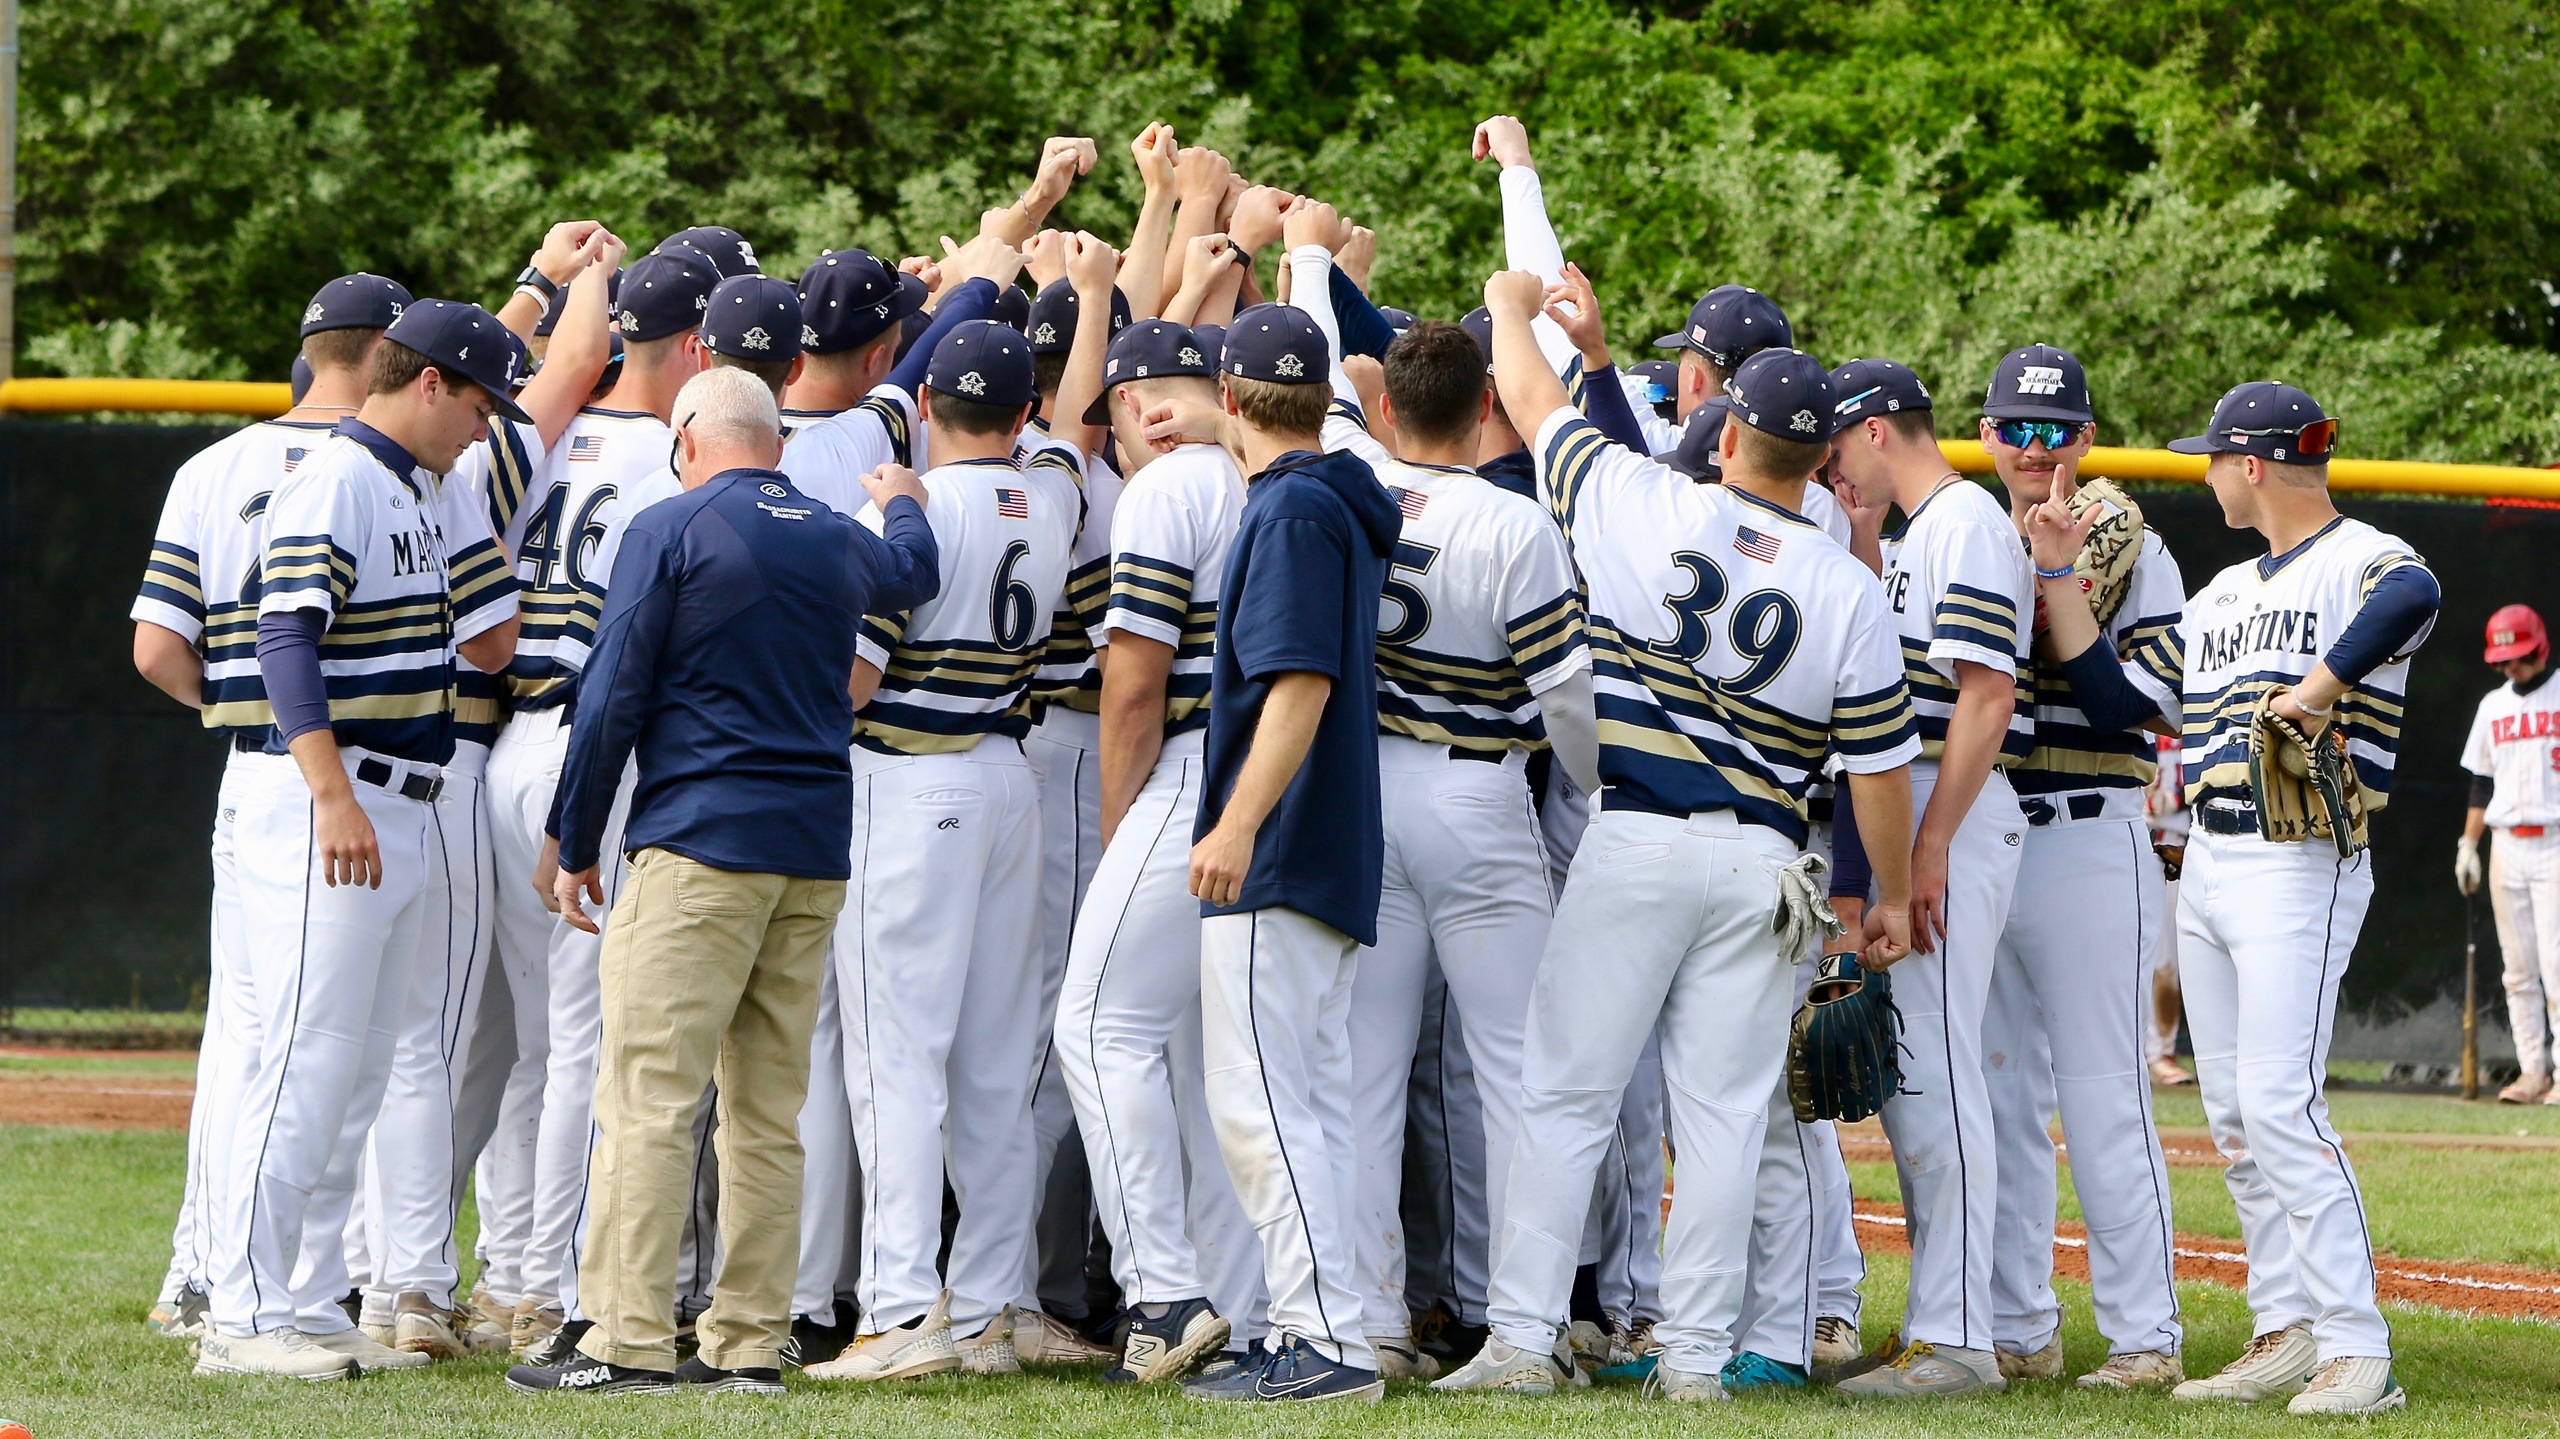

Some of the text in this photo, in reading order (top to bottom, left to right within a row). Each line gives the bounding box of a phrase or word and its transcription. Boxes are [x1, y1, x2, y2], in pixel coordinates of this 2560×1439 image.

[695, 294, 708, 310] 46
[875, 304, 889, 319] 33
[458, 346, 469, 361] 4
[517, 480, 618, 591] 46
[988, 539, 1038, 652] 6
[1376, 538, 1441, 646] 5
[1648, 550, 1803, 696] 39
[2197, 609, 2318, 673] MARITIME
[201, 1337, 230, 1361] HOKA
[559, 1365, 613, 1387] HOKA
